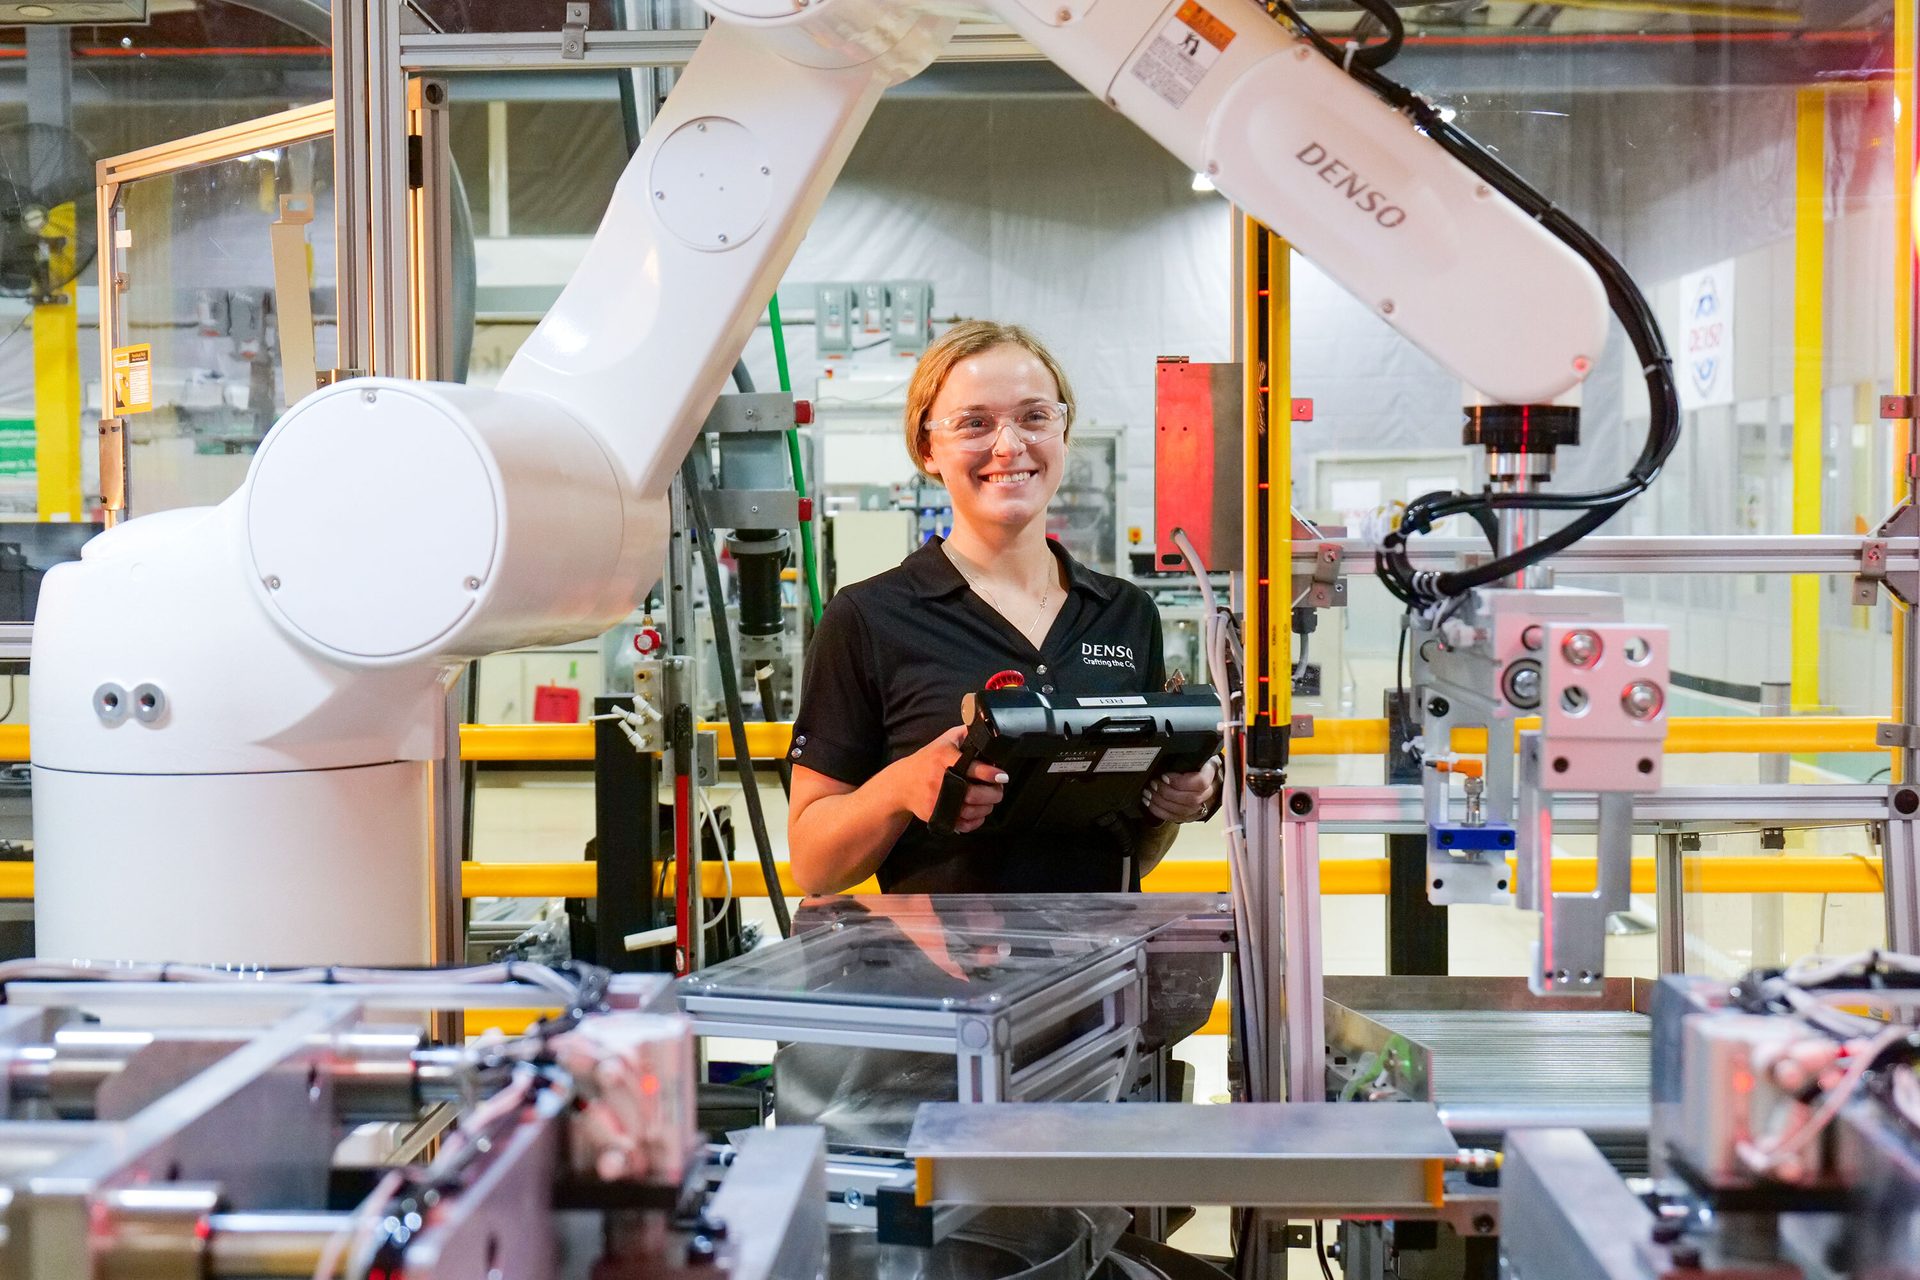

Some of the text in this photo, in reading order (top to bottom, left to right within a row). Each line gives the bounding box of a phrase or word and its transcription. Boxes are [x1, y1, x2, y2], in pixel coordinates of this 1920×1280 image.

[1296, 142, 1406, 228] DENSO
[1082, 642, 1133, 660] DENSO
[1083, 657, 1112, 668] Crafting
[1112, 659, 1124, 668] the
